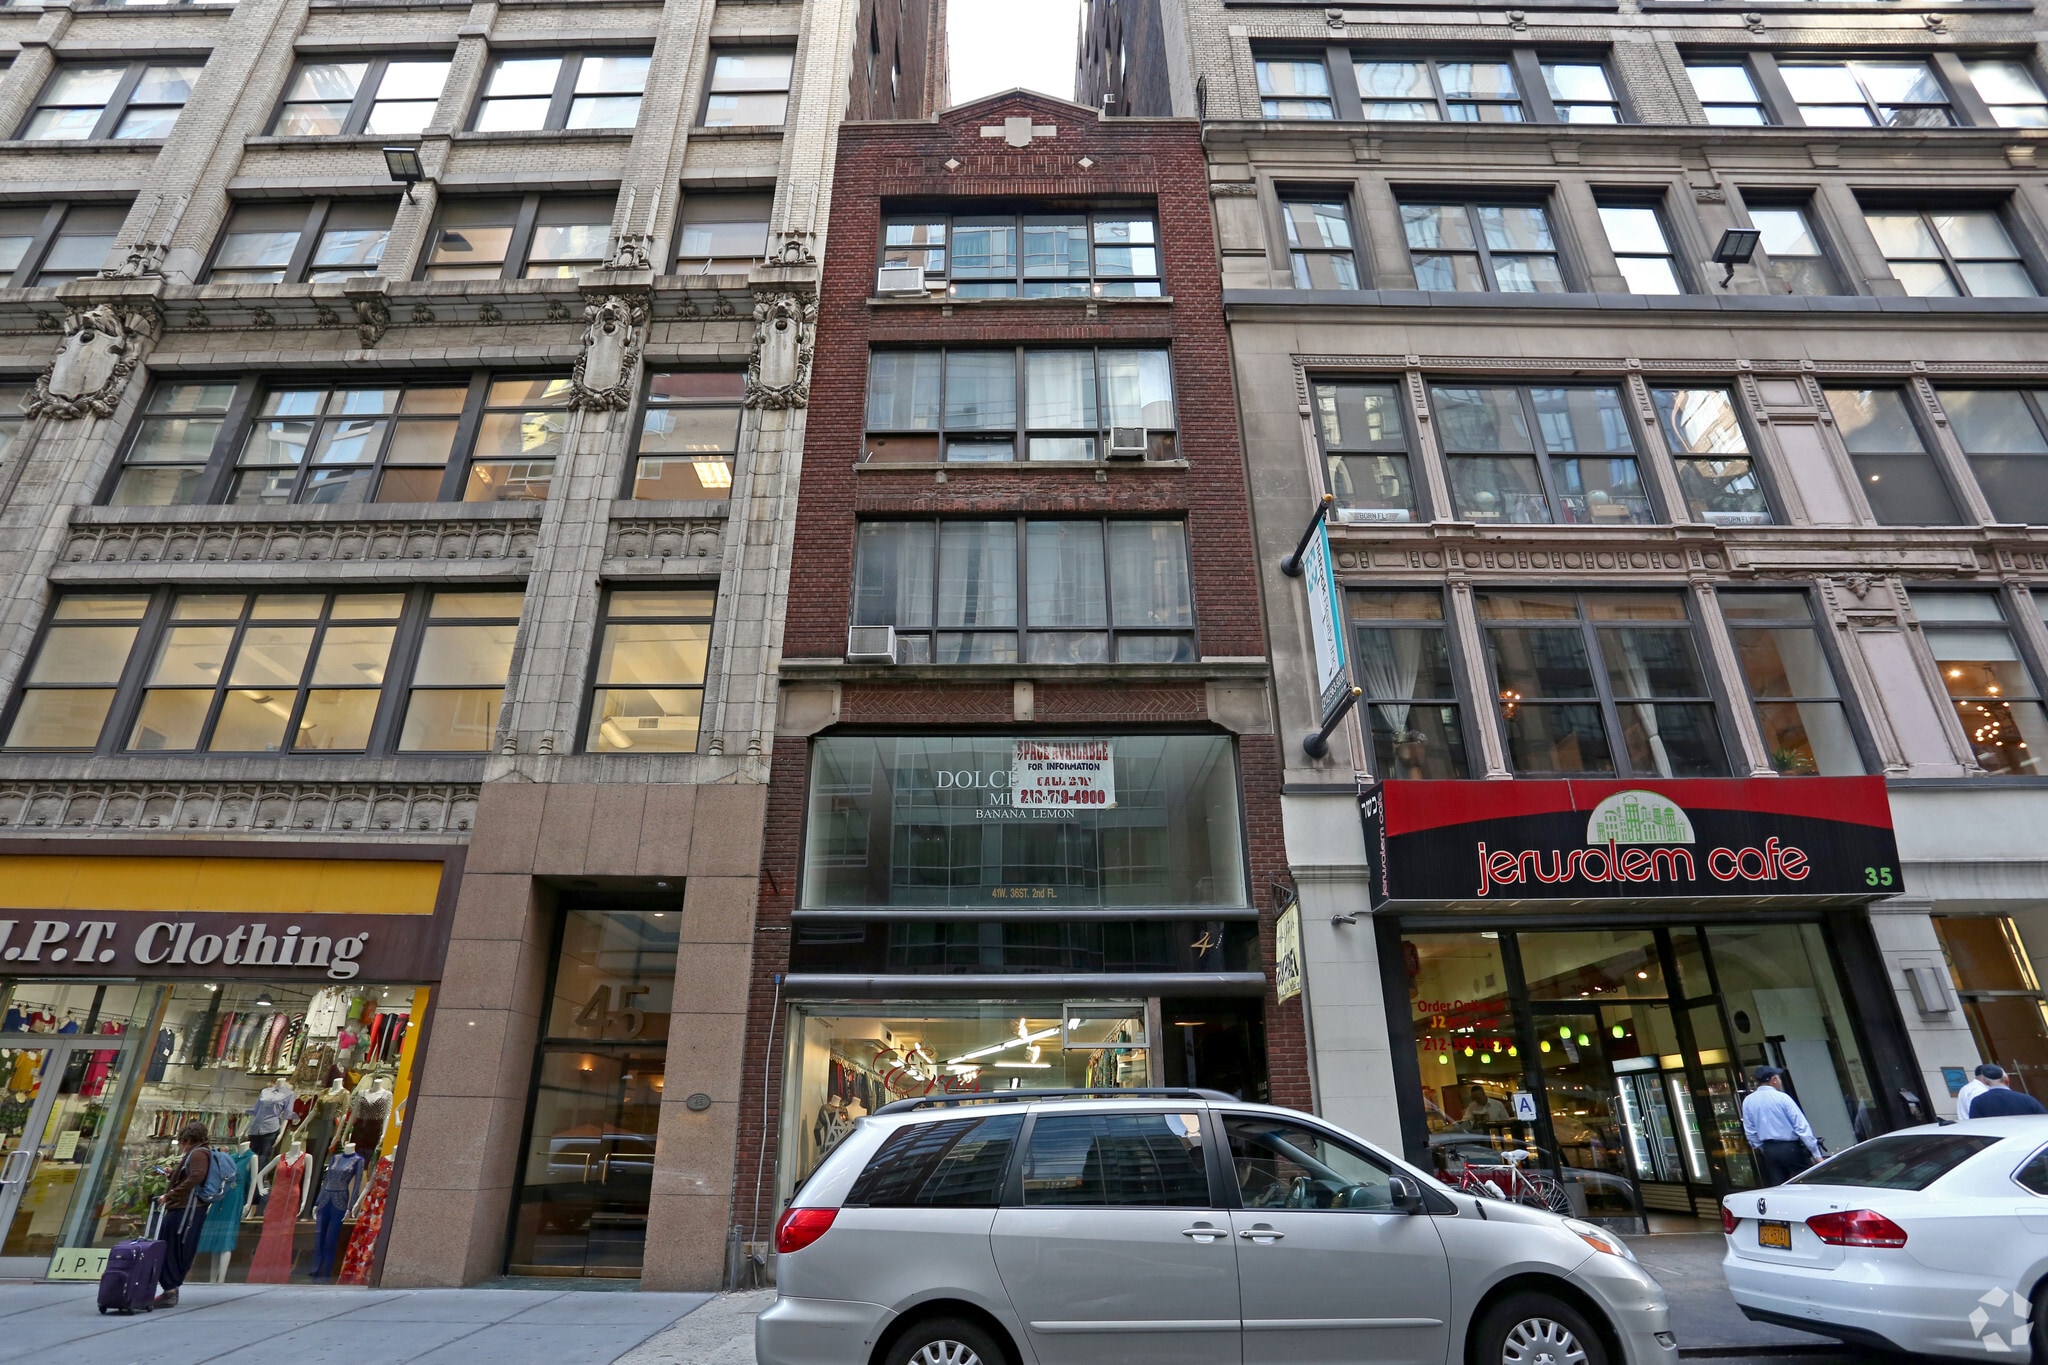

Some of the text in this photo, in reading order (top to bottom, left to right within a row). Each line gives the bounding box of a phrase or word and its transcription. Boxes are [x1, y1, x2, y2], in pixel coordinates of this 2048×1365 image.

[1017, 740, 1109, 760] SPACE AVAILABLE
[1028, 763, 1100, 771] FOR INFORMATION
[975, 809, 1075, 818] BANANA LEMON
[1477, 837, 1811, 896] jerusalem cafe
[1864, 867, 1893, 886] 35
[1032, 888, 1045, 898] 2nd
[134, 922, 369, 979] Clothing
[574, 984, 650, 1040] 45
[1418, 1001, 1452, 1013] Order
[1520, 1098, 1532, 1112] A
[54, 1257, 66, 1273] J.
[74, 1257, 88, 1274] P.
